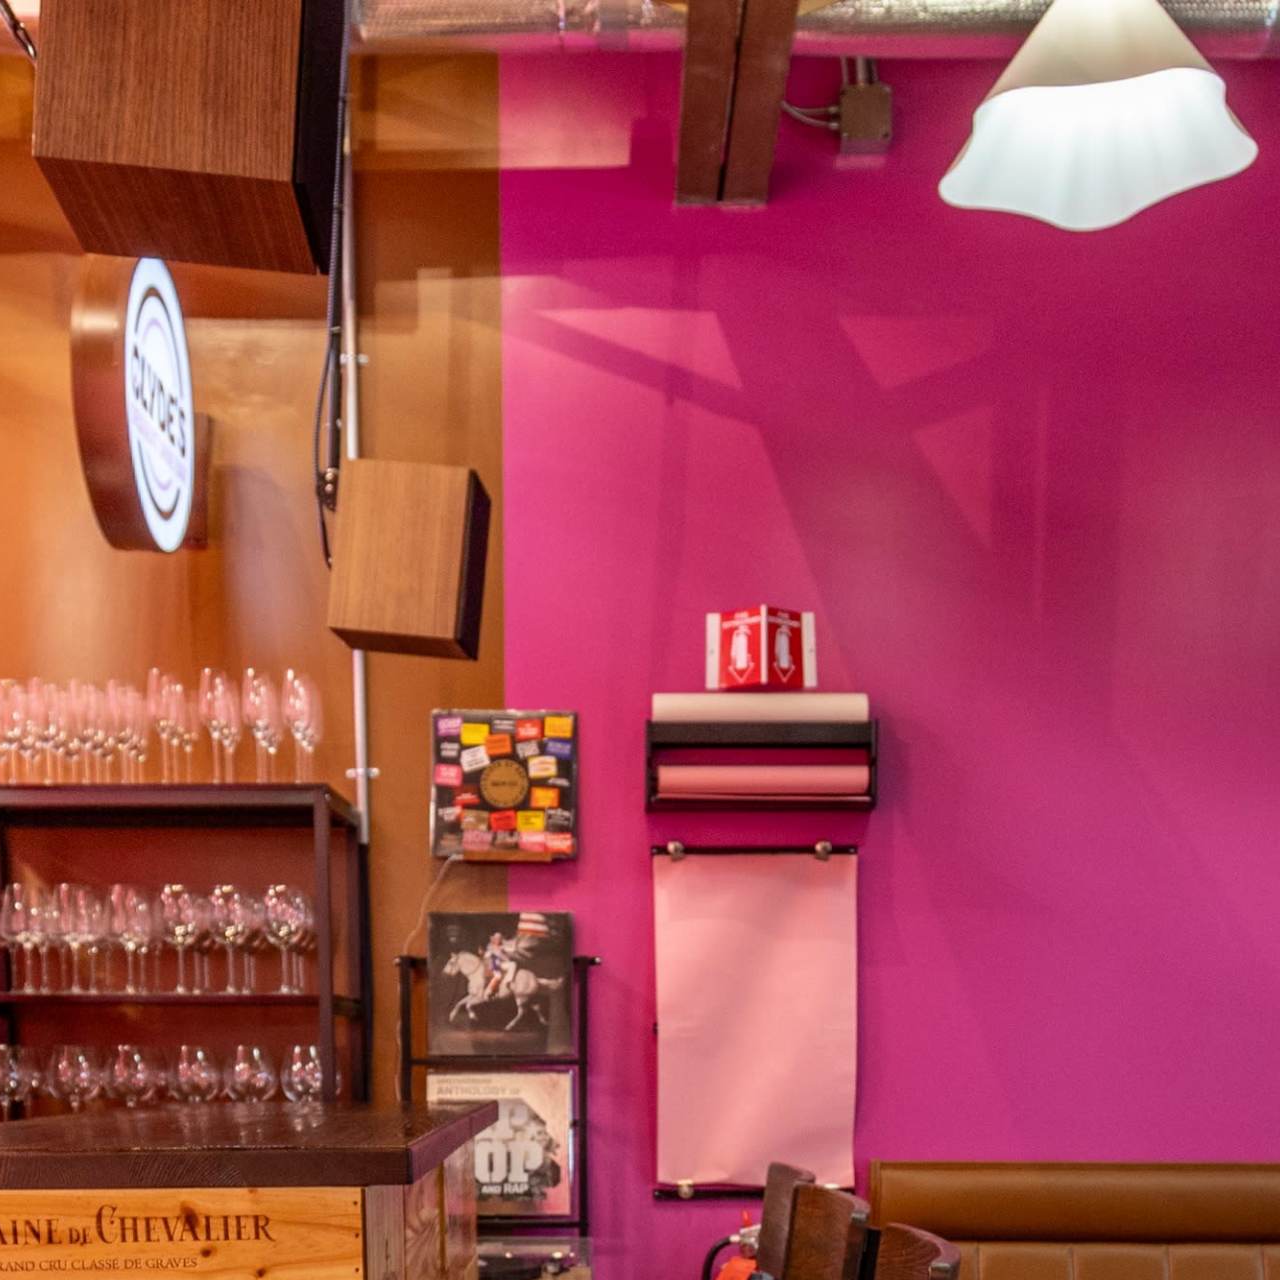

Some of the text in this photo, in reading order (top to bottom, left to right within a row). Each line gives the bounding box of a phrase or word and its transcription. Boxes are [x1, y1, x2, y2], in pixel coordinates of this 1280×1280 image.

[503, 1183, 530, 1194] RAP
[68, 1226, 93, 1246] DE
[95, 1204, 276, 1245] CHEVALIER
[38, 1259, 67, 1272] CRU
[123, 1258, 142, 1270] DE
[145, 1257, 198, 1270] GRAVES
